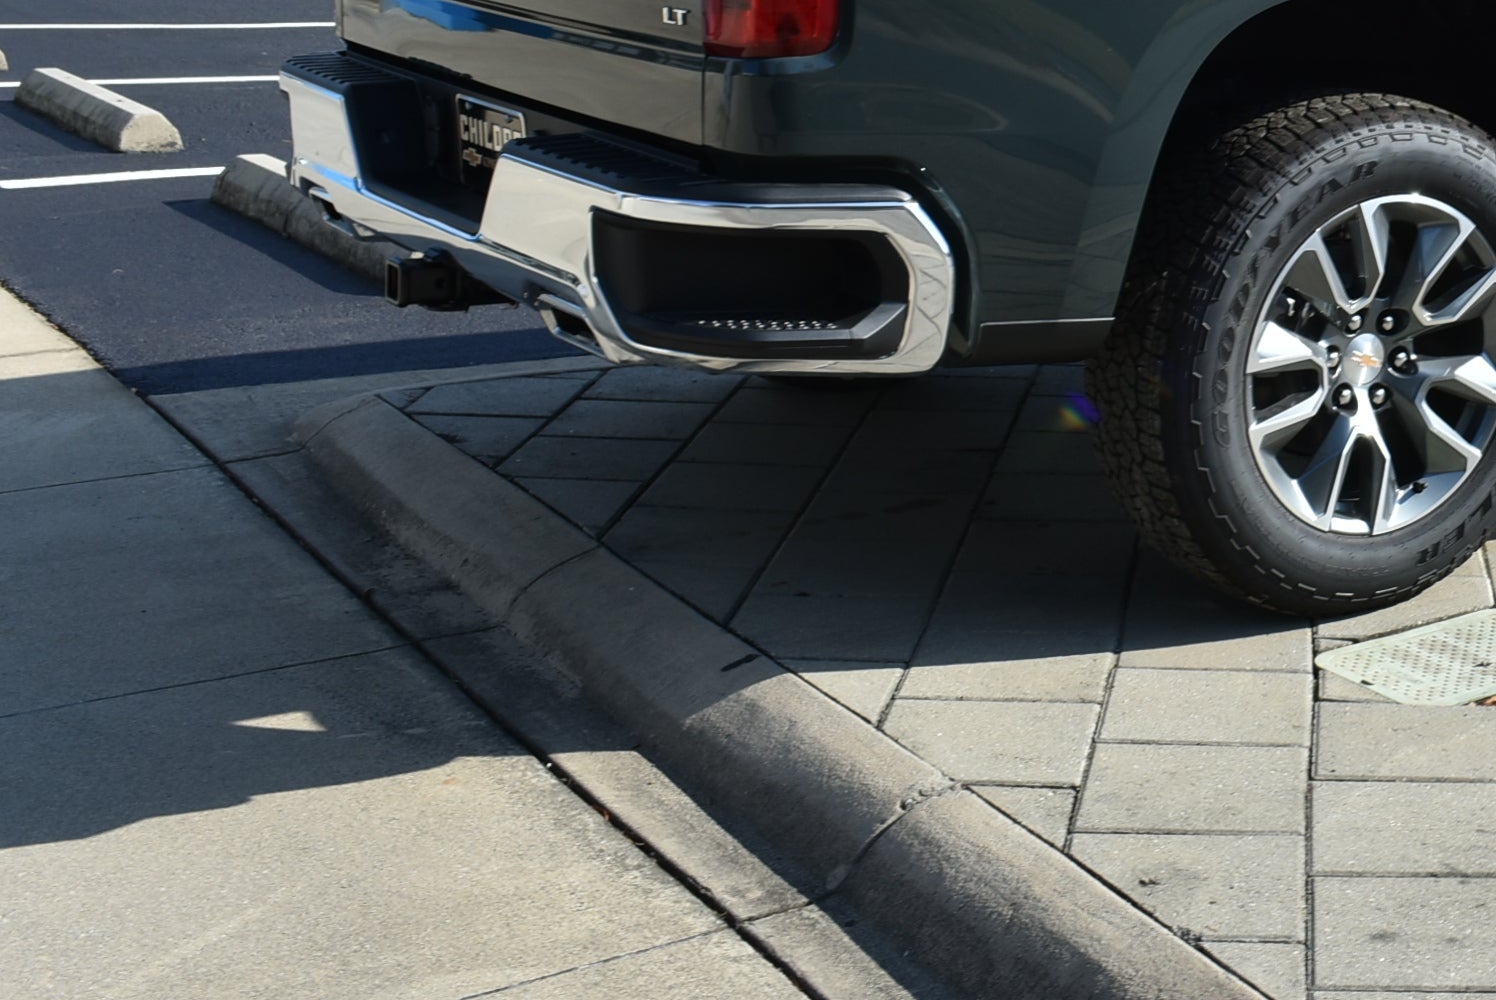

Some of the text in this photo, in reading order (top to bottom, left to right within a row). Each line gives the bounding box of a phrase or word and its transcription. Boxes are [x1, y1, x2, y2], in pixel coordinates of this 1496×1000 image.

[662, 7, 688, 25] LT
[459, 113, 522, 152] CHILDR
[1212, 160, 1377, 447] GOODYEAR
